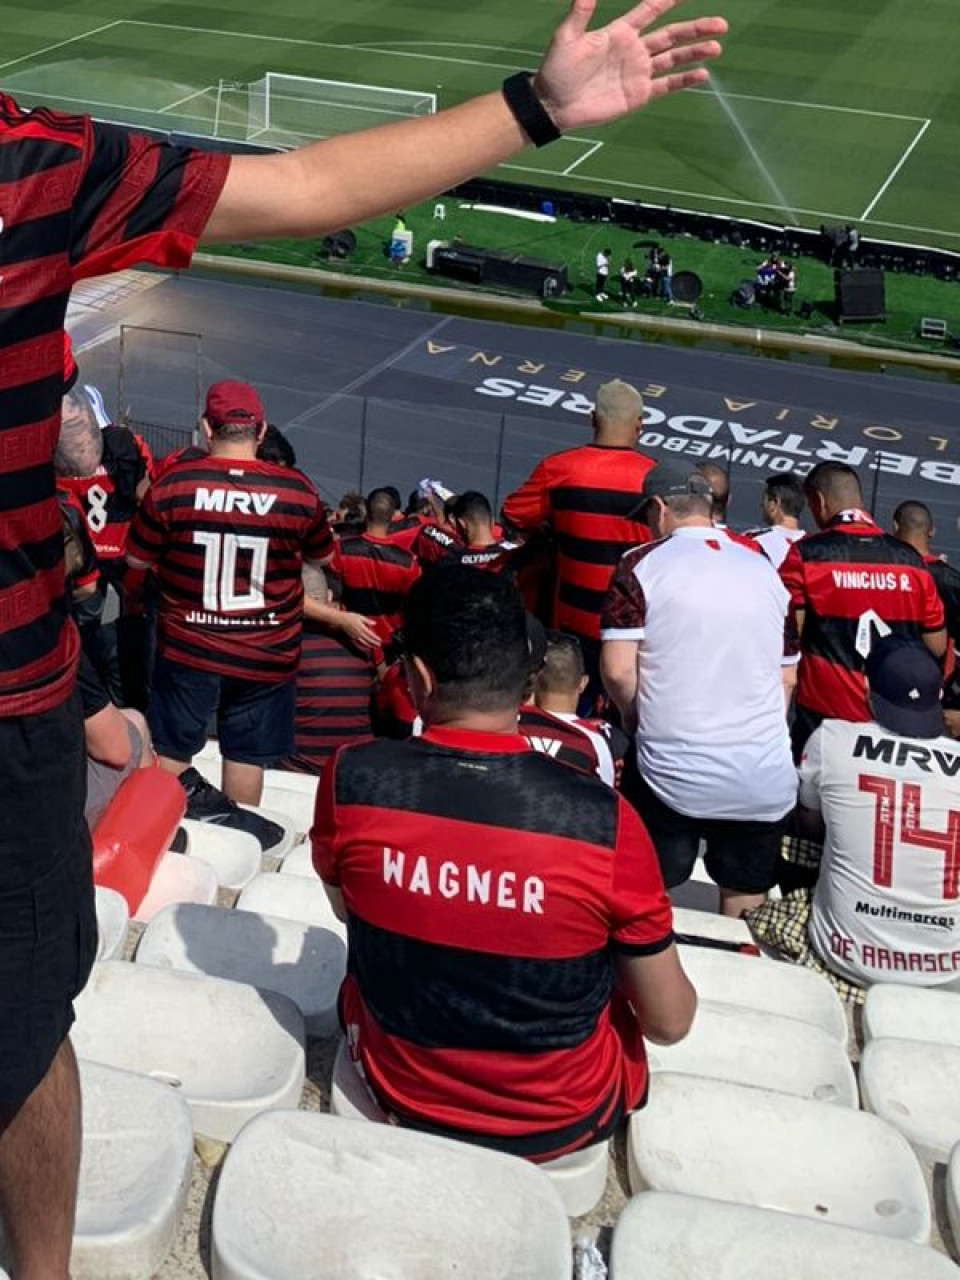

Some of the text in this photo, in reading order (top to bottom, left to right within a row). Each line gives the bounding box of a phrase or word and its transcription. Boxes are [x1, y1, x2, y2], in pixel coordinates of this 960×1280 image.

[426, 340, 667, 398] EERNA
[638, 430, 817, 477] CONMEBO
[87, 484, 108, 534] 8
[194, 487, 278, 516] MRV
[192, 530, 270, 612] 10
[832, 569, 897, 590] VINICIUS
[852, 735, 960, 777] MRV
[857, 773, 960, 901] 14
[382, 846, 545, 915] WAGNER
[854, 900, 956, 931] Multimarcas
[829, 933, 960, 972] DE ARRASCA
